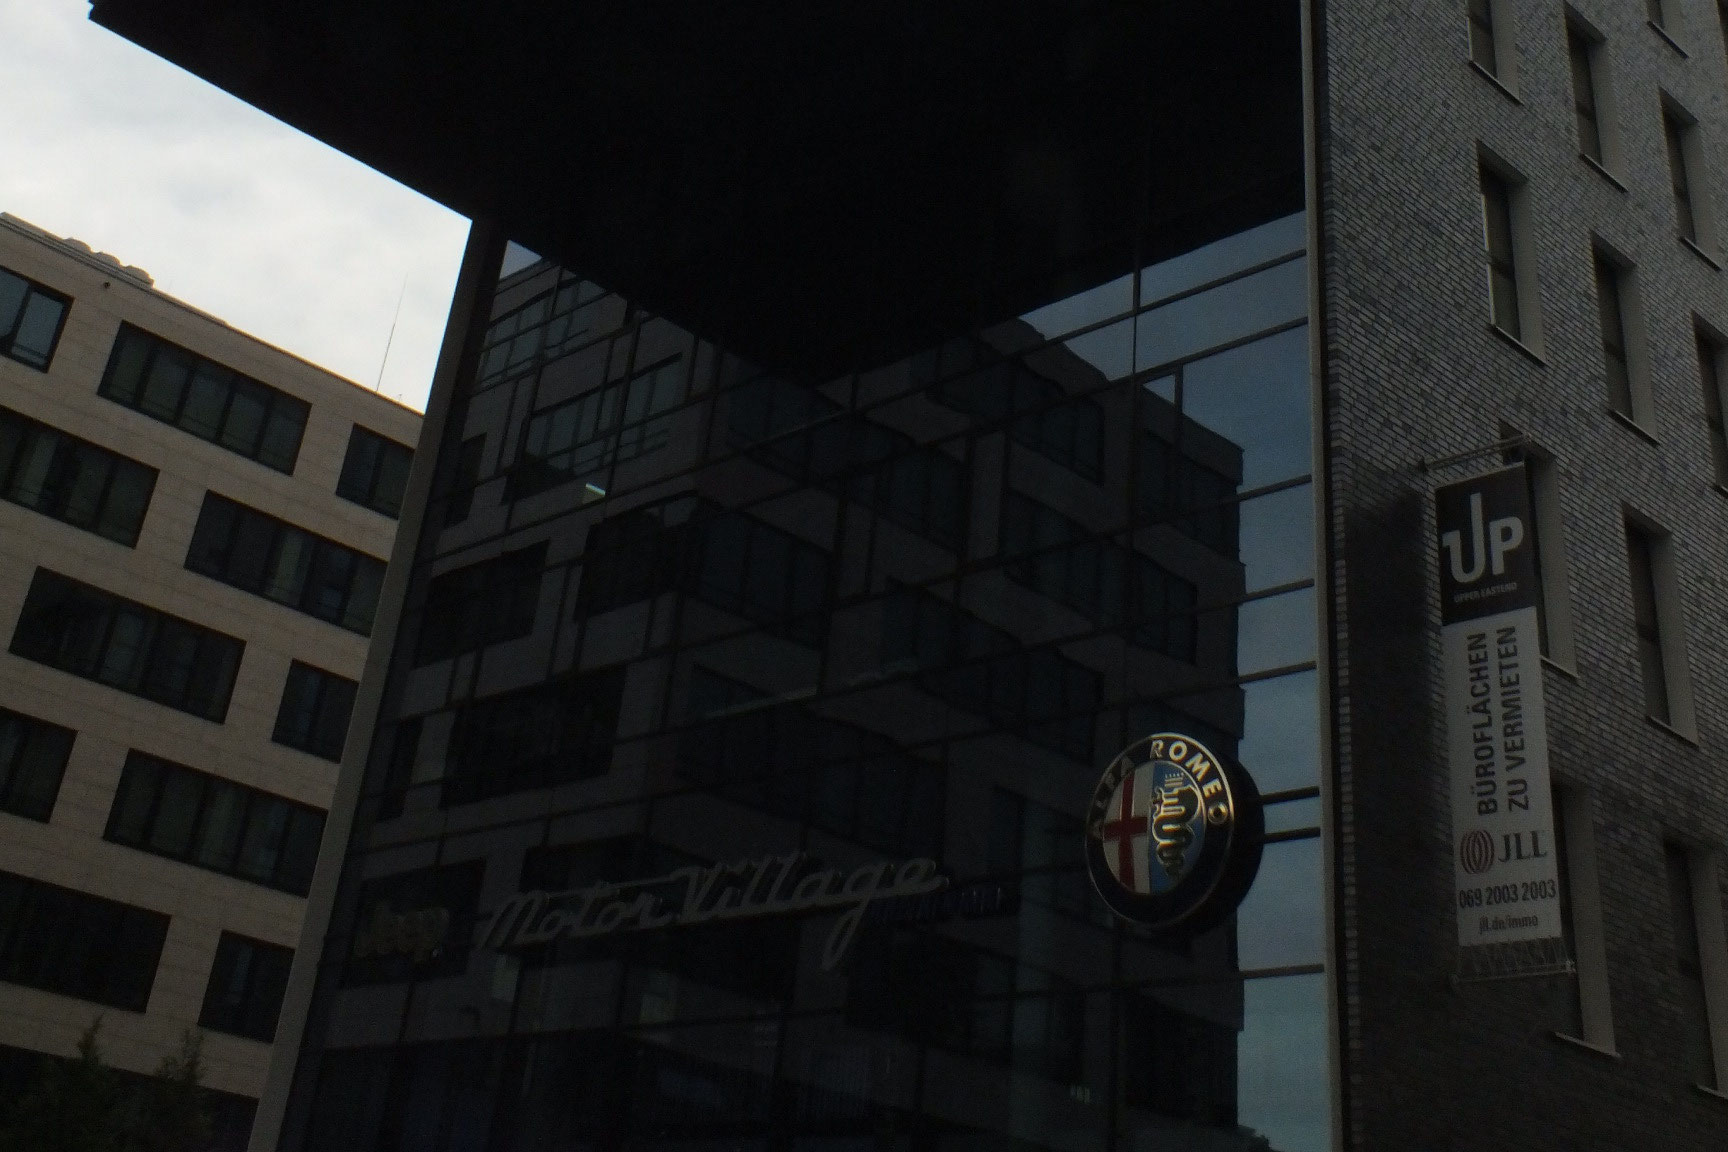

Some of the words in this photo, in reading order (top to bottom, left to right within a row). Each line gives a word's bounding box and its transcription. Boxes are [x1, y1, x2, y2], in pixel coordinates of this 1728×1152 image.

[1465, 632, 1498, 816] BÜROFLÄCHEN
[1496, 625, 1527, 772] VERMIETEN
[1150, 738, 1229, 826] ROMEO
[1506, 778, 1530, 812] ZU
[1498, 830, 1548, 862] JLL
[476, 878, 675, 950] Motor
[673, 850, 951, 971] Village
[1458, 888, 1482, 909] 069
[1485, 884, 1519, 905] 2003
[1522, 879, 1557, 901] 2003
